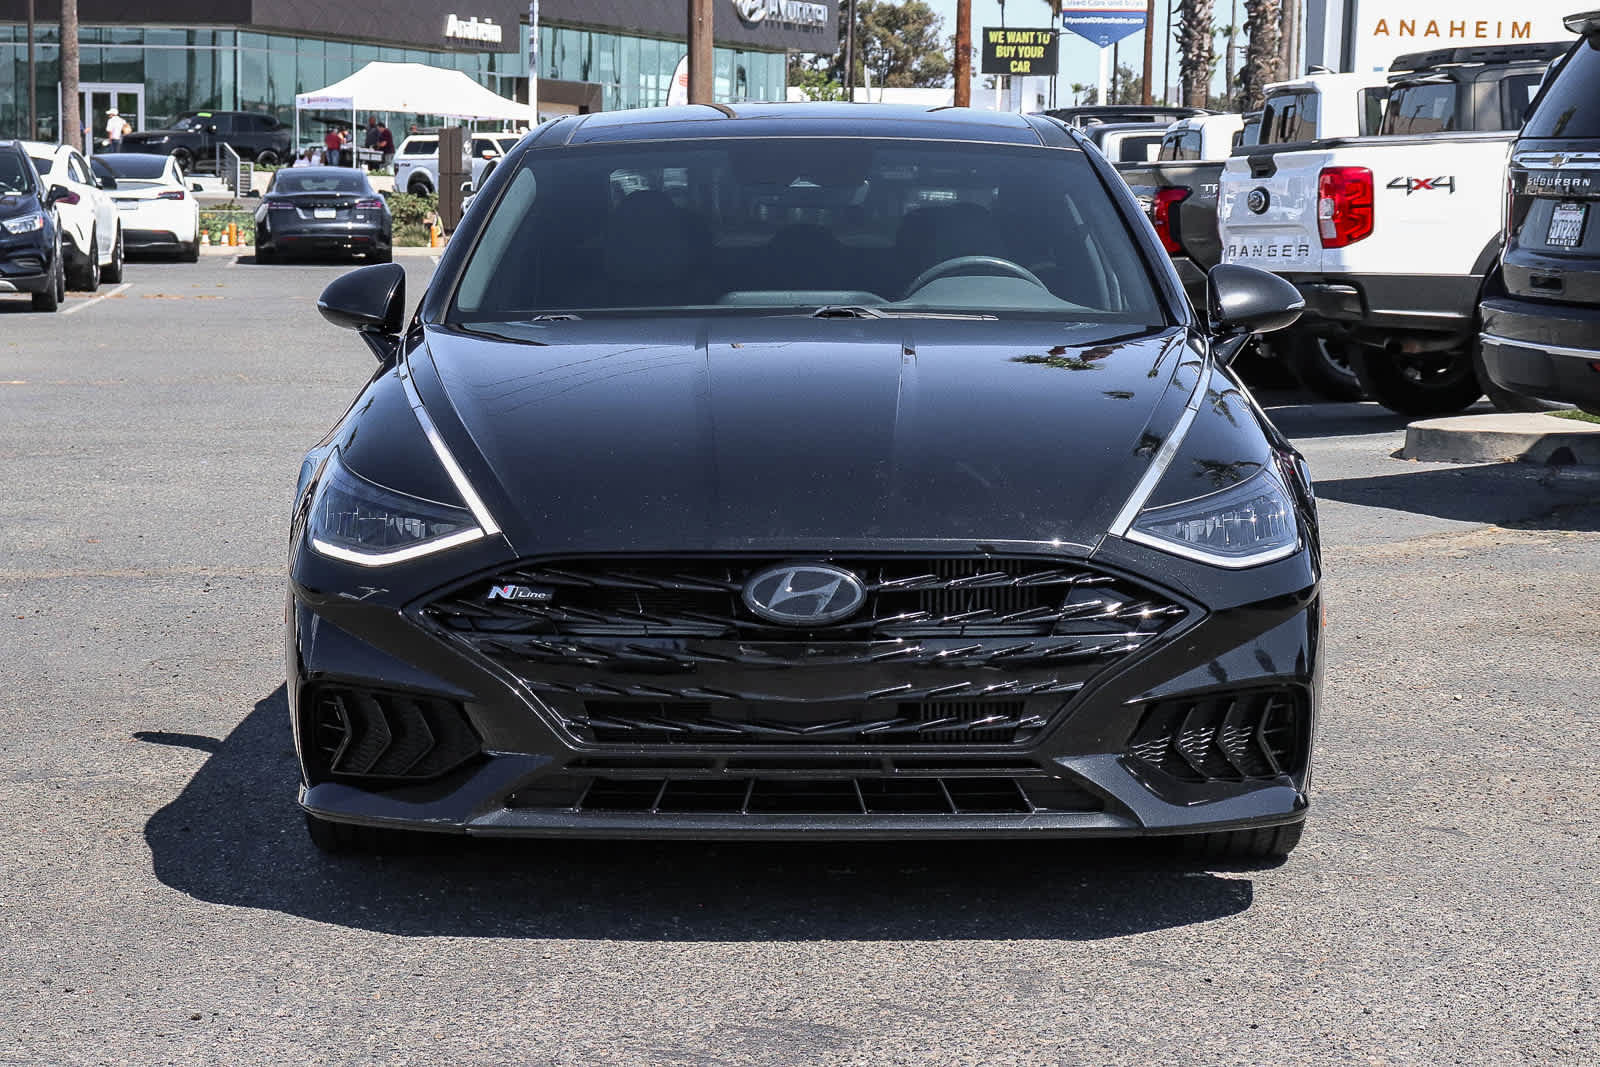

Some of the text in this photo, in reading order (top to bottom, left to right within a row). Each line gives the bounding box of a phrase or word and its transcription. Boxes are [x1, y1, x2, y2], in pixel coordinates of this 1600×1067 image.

[1373, 19, 1532, 39] ANAHEIM
[989, 31, 1050, 44] WE WANT TO
[996, 45, 1044, 58] BUY YOUR
[1010, 60, 1030, 73] CAR
[1527, 177, 1591, 187] SUBURBAN
[1227, 244, 1310, 257] RANGER
[518, 591, 546, 599] Line
